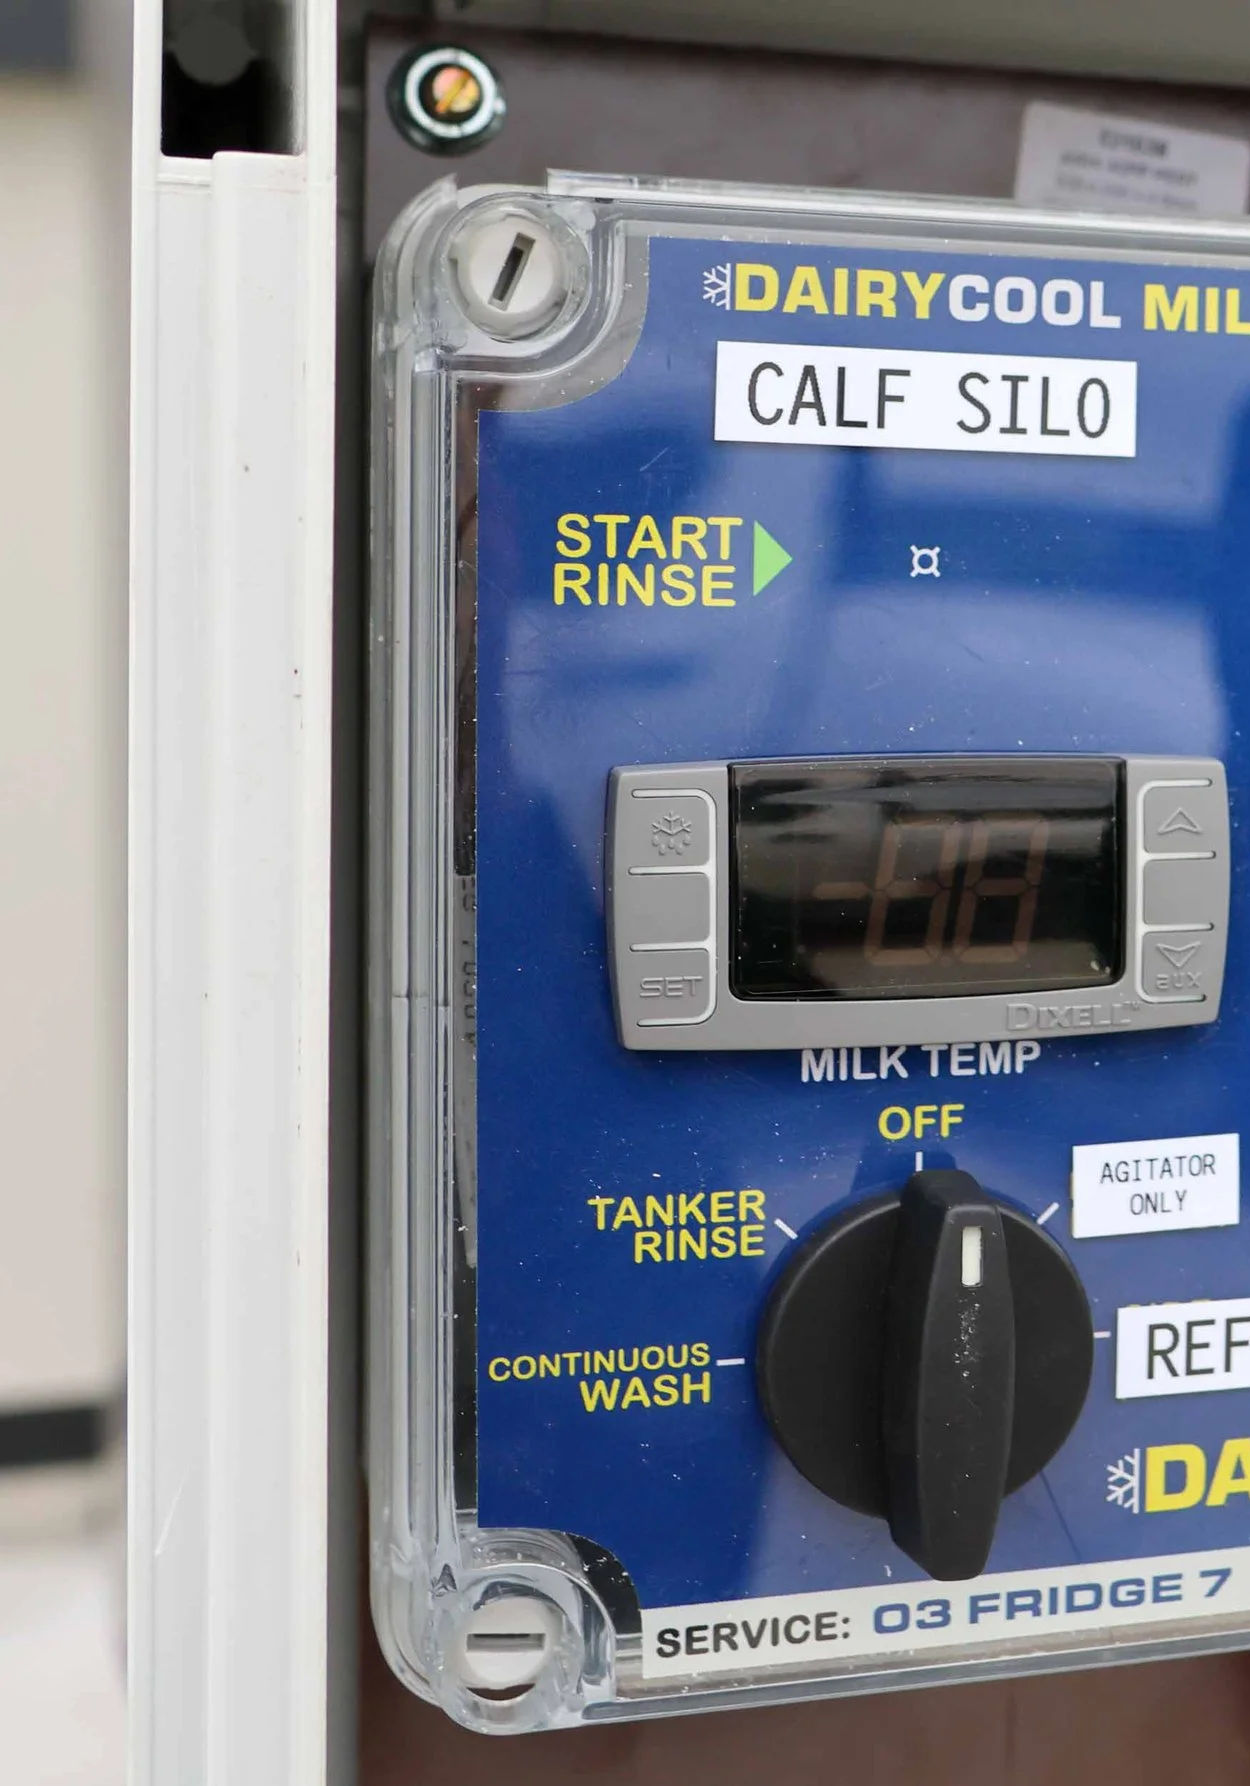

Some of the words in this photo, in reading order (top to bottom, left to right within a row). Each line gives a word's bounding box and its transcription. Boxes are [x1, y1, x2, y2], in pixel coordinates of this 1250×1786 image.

[735, 263, 1122, 329] DAIRYCOOL
[748, 361, 912, 430] CALF
[956, 371, 1111, 440] SILO
[556, 513, 743, 561] START
[554, 562, 736, 607] RINSE
[639, 975, 703, 999] SET
[801, 1045, 909, 1083] MILK
[921, 1040, 1042, 1078] TEMP
[878, 1103, 965, 1140] OFF
[1100, 1153, 1216, 1184] AGITATOR
[587, 1189, 765, 1230] TANKER
[1130, 1190, 1187, 1215] ONLY
[634, 1224, 765, 1264] RINSE
[488, 1343, 711, 1381] CONTINUOUS
[579, 1371, 711, 1412] WASH
[656, 1611, 850, 1658] SERVICE:
[968, 1572, 1184, 1625] FRIDGE
[1199, 1567, 1233, 1598] 7
